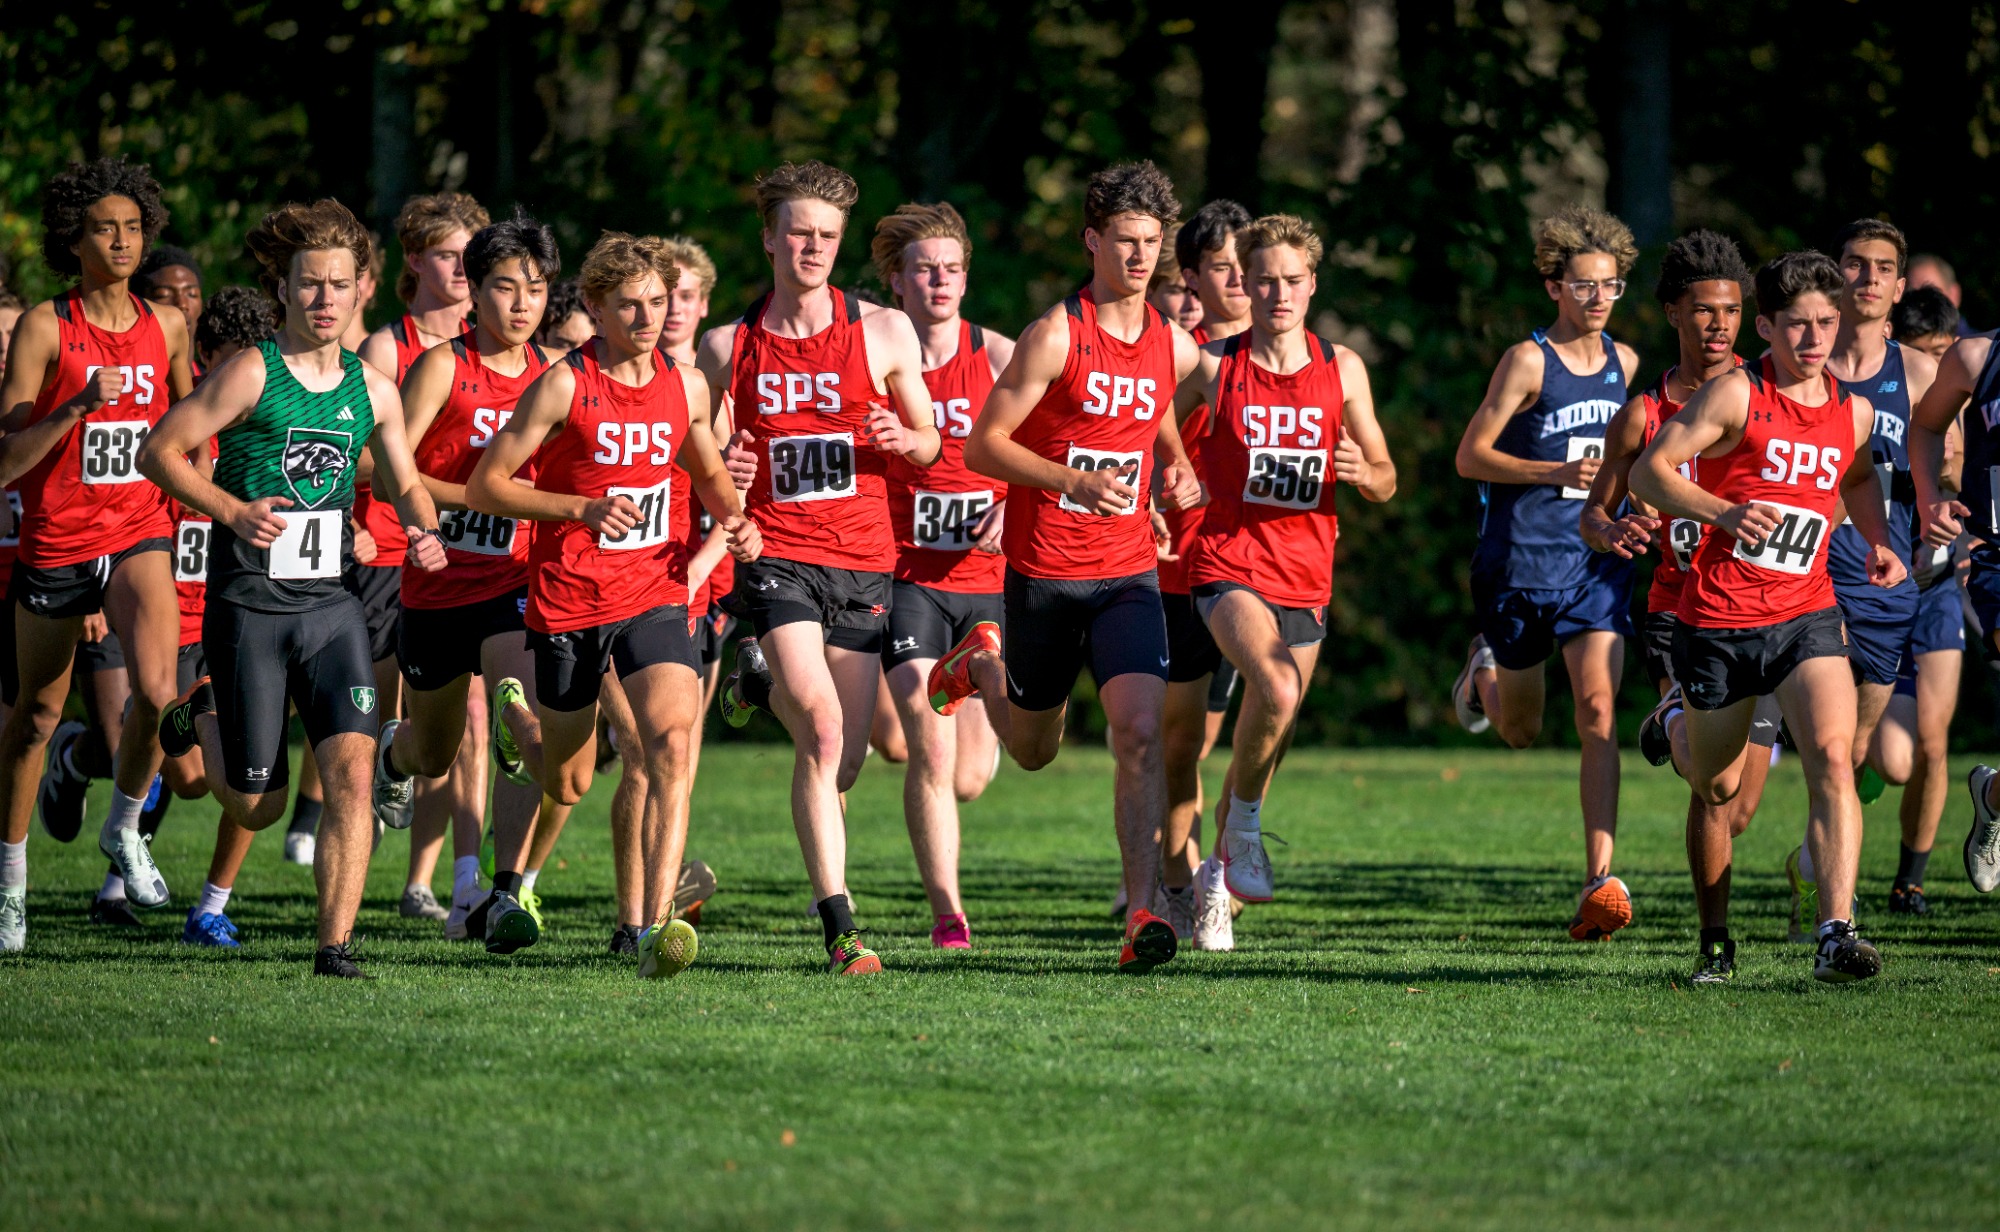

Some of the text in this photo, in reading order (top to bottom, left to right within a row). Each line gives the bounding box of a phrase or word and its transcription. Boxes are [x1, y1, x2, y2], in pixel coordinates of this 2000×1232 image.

[757, 371, 842, 415] SPS
[1083, 371, 1156, 420] SPS
[1878, 381, 1899, 393] NB
[594, 421, 673, 466] SPS
[1242, 405, 1323, 447] SPS
[87, 427, 151, 478] 33
[773, 439, 852, 495] 349
[1761, 438, 1841, 490] SPS
[1250, 453, 1322, 503] 356
[441, 510, 513, 549] 346
[918, 496, 988, 543] 345
[181, 527, 211, 575] 3
[299, 518, 322, 570] 4
